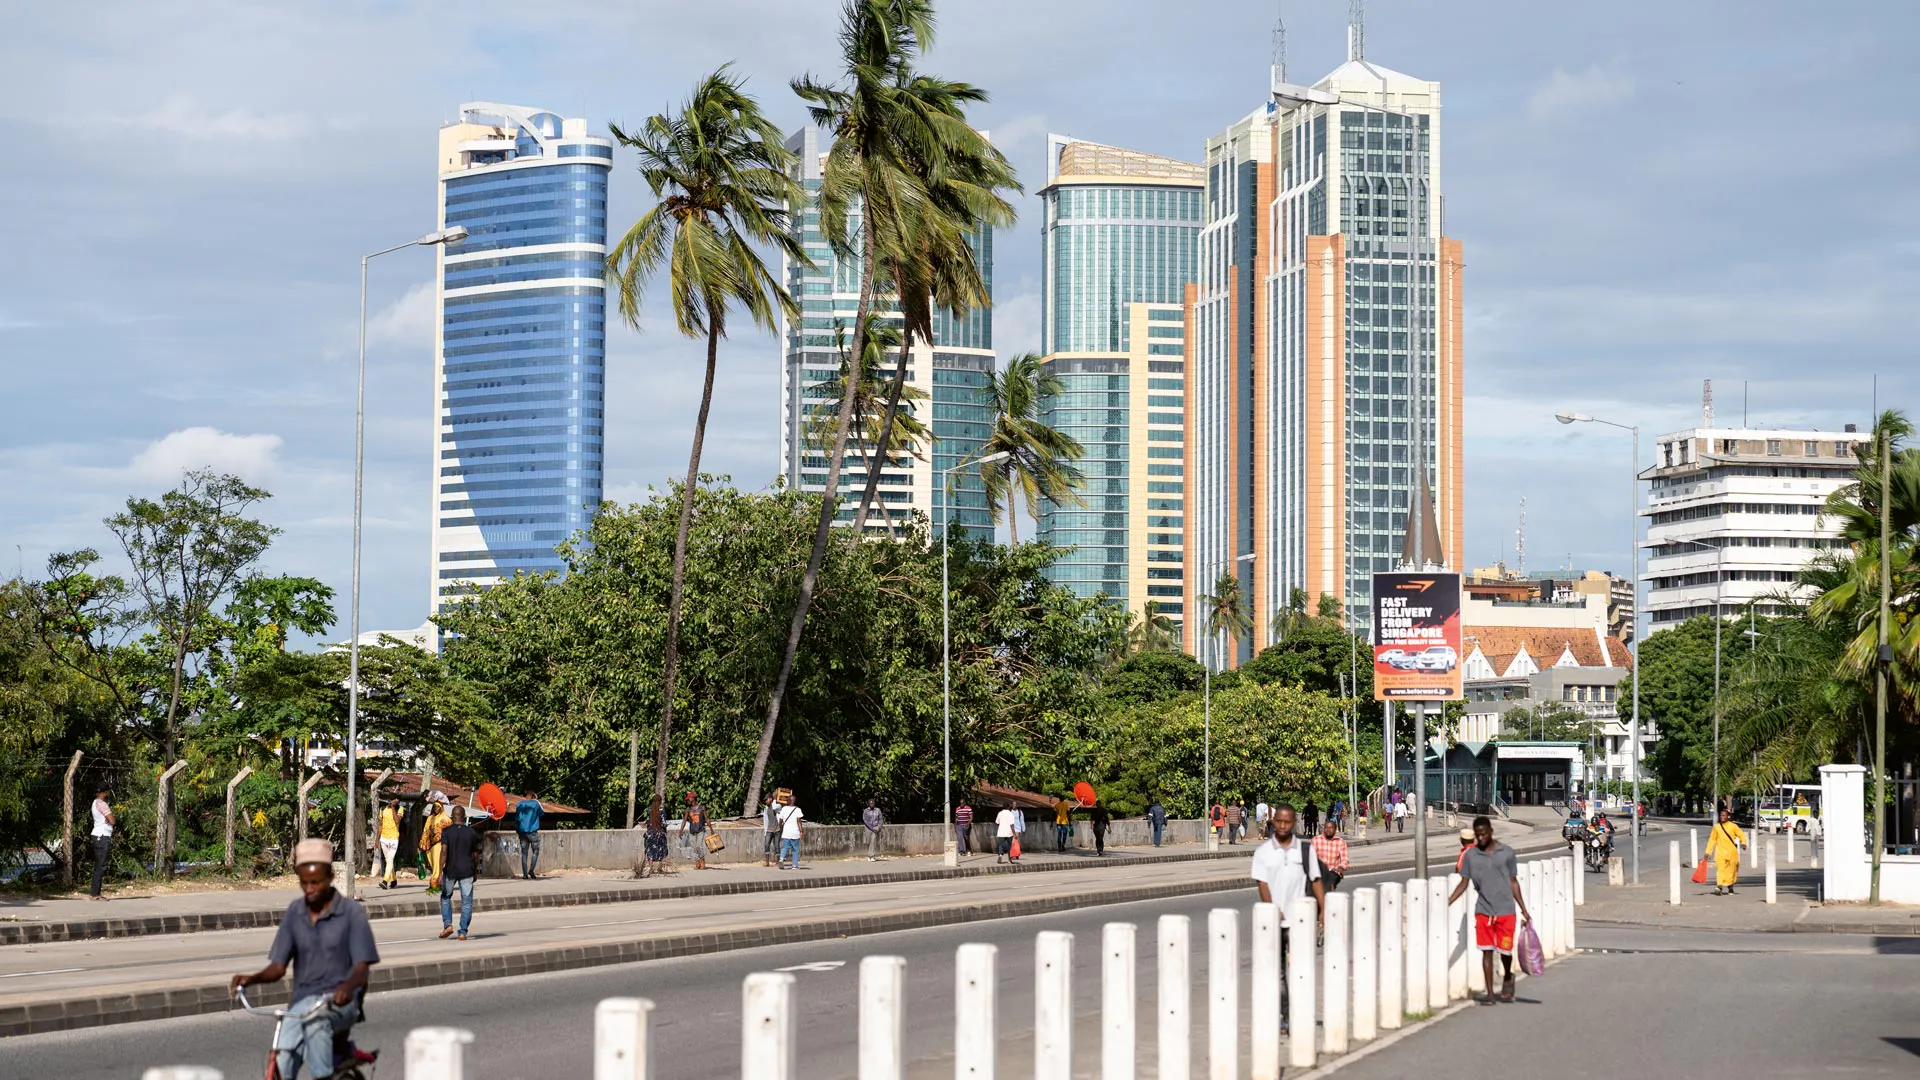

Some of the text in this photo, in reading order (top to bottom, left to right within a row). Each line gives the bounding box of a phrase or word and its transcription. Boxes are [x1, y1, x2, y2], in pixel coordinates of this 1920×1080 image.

[1381, 597, 1407, 607] FAST
[1381, 607, 1432, 617] DELIVERY
[1381, 618, 1412, 628] FROM
[1381, 628, 1443, 638] SINGAPORE
